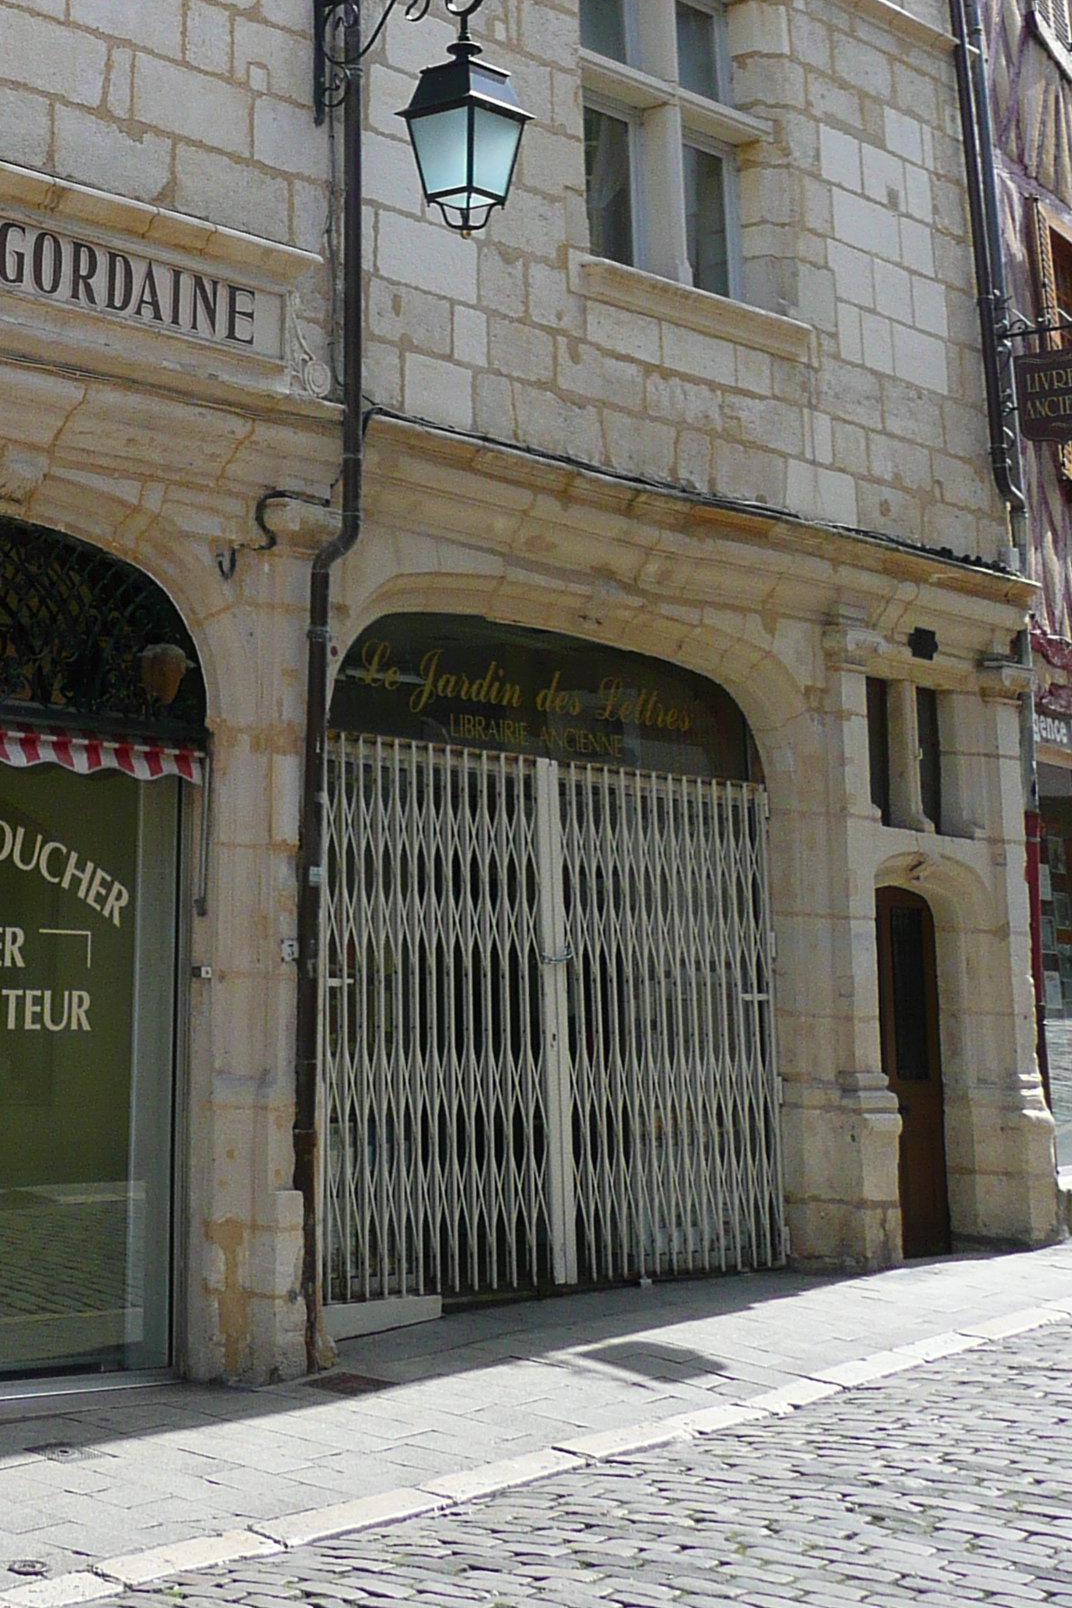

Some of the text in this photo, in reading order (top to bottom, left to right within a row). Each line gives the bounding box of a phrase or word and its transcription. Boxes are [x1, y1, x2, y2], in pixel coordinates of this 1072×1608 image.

[355, 640, 691, 731] Le Jardin des Lettres
[449, 712, 624, 758] LIBRAIRIE ANCIENNE
